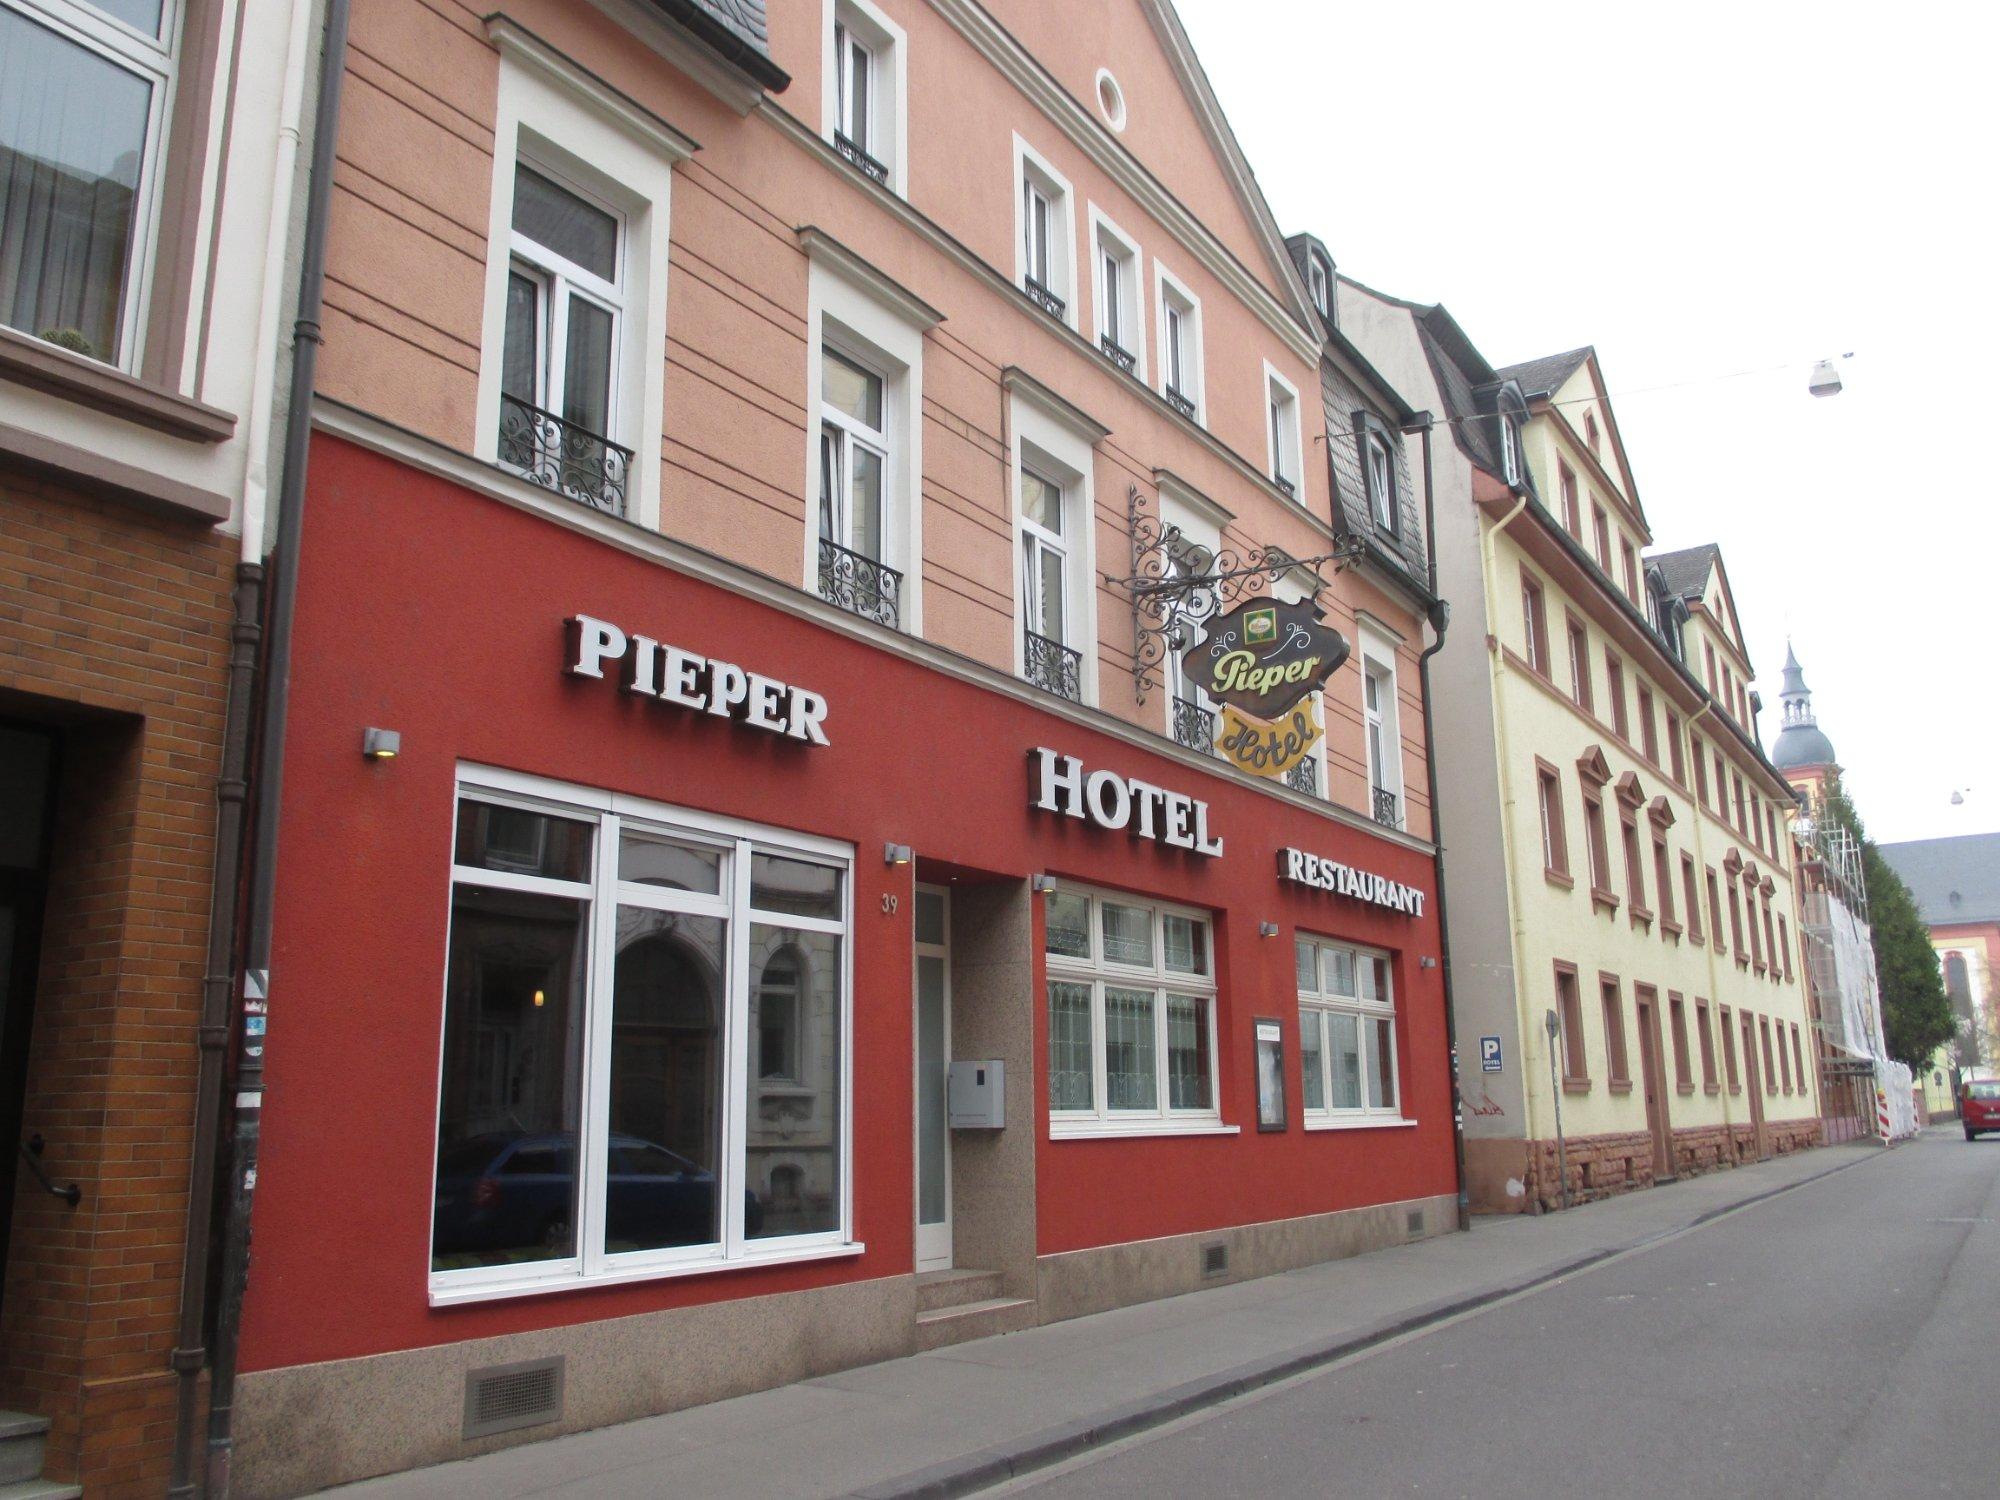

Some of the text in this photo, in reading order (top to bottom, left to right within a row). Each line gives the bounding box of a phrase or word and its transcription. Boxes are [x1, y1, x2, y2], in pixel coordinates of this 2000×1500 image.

[573, 613, 831, 747] PIEPER
[1211, 650, 1321, 696] Pieper
[1223, 712, 1314, 769] Hotel
[1036, 746, 1224, 857] HOTEL
[882, 893, 897, 914] 39
[1286, 847, 1425, 917] RESTAURANT
[1483, 1040, 1499, 1059] P
